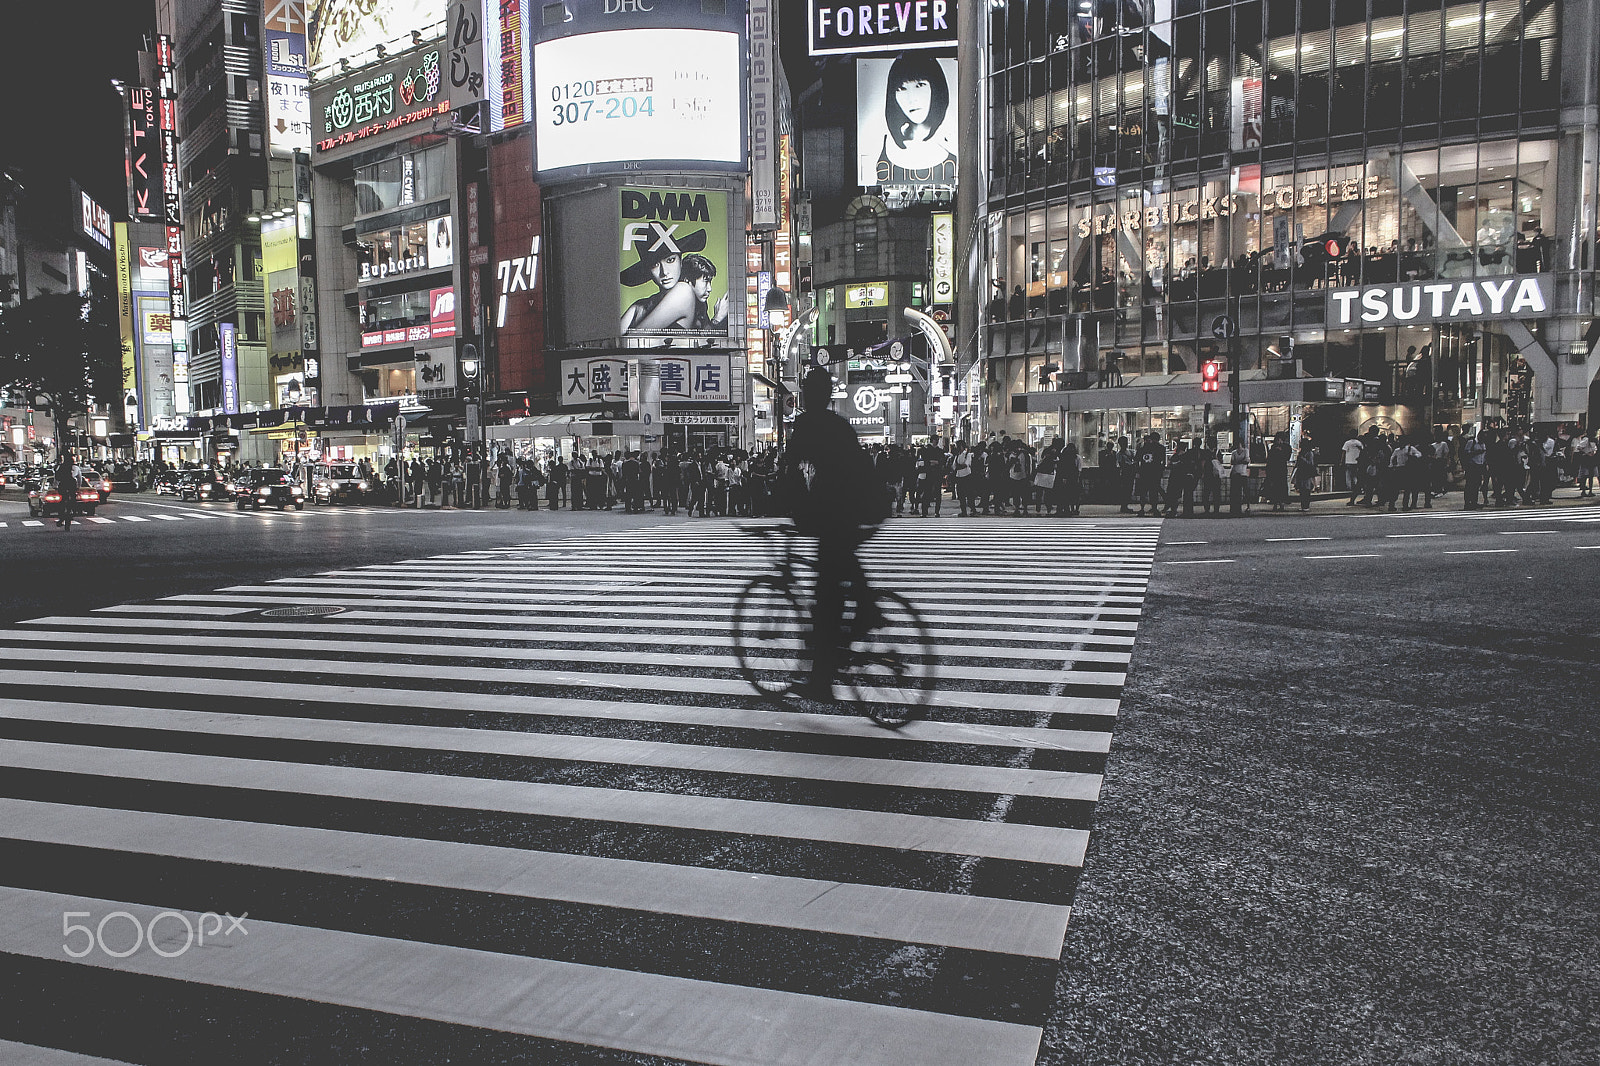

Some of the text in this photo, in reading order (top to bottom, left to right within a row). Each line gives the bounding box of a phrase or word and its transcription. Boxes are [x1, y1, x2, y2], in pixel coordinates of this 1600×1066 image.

[603, 0, 654, 14] DHC
[819, 0, 948, 38] FOREVER
[280, 99, 303, 112] まで
[355, 85, 393, 123] 西村
[551, 80, 594, 101] 0120
[145, 90, 154, 128] TOKYO
[552, 96, 655, 126] 307-204
[290, 120, 311, 135] 地下
[754, 93, 767, 161] neon
[131, 88, 149, 213] KATE
[623, 162, 642, 170] DHC
[621, 190, 710, 222] DMM
[1077, 176, 1379, 240] STARBUCKS COFFEE
[622, 222, 680, 252] FX
[361, 256, 425, 279] Euphoria
[937, 283, 949, 293] 4F
[1332, 278, 1546, 324] TSUTAYA
[432, 292, 454, 318] JTB
